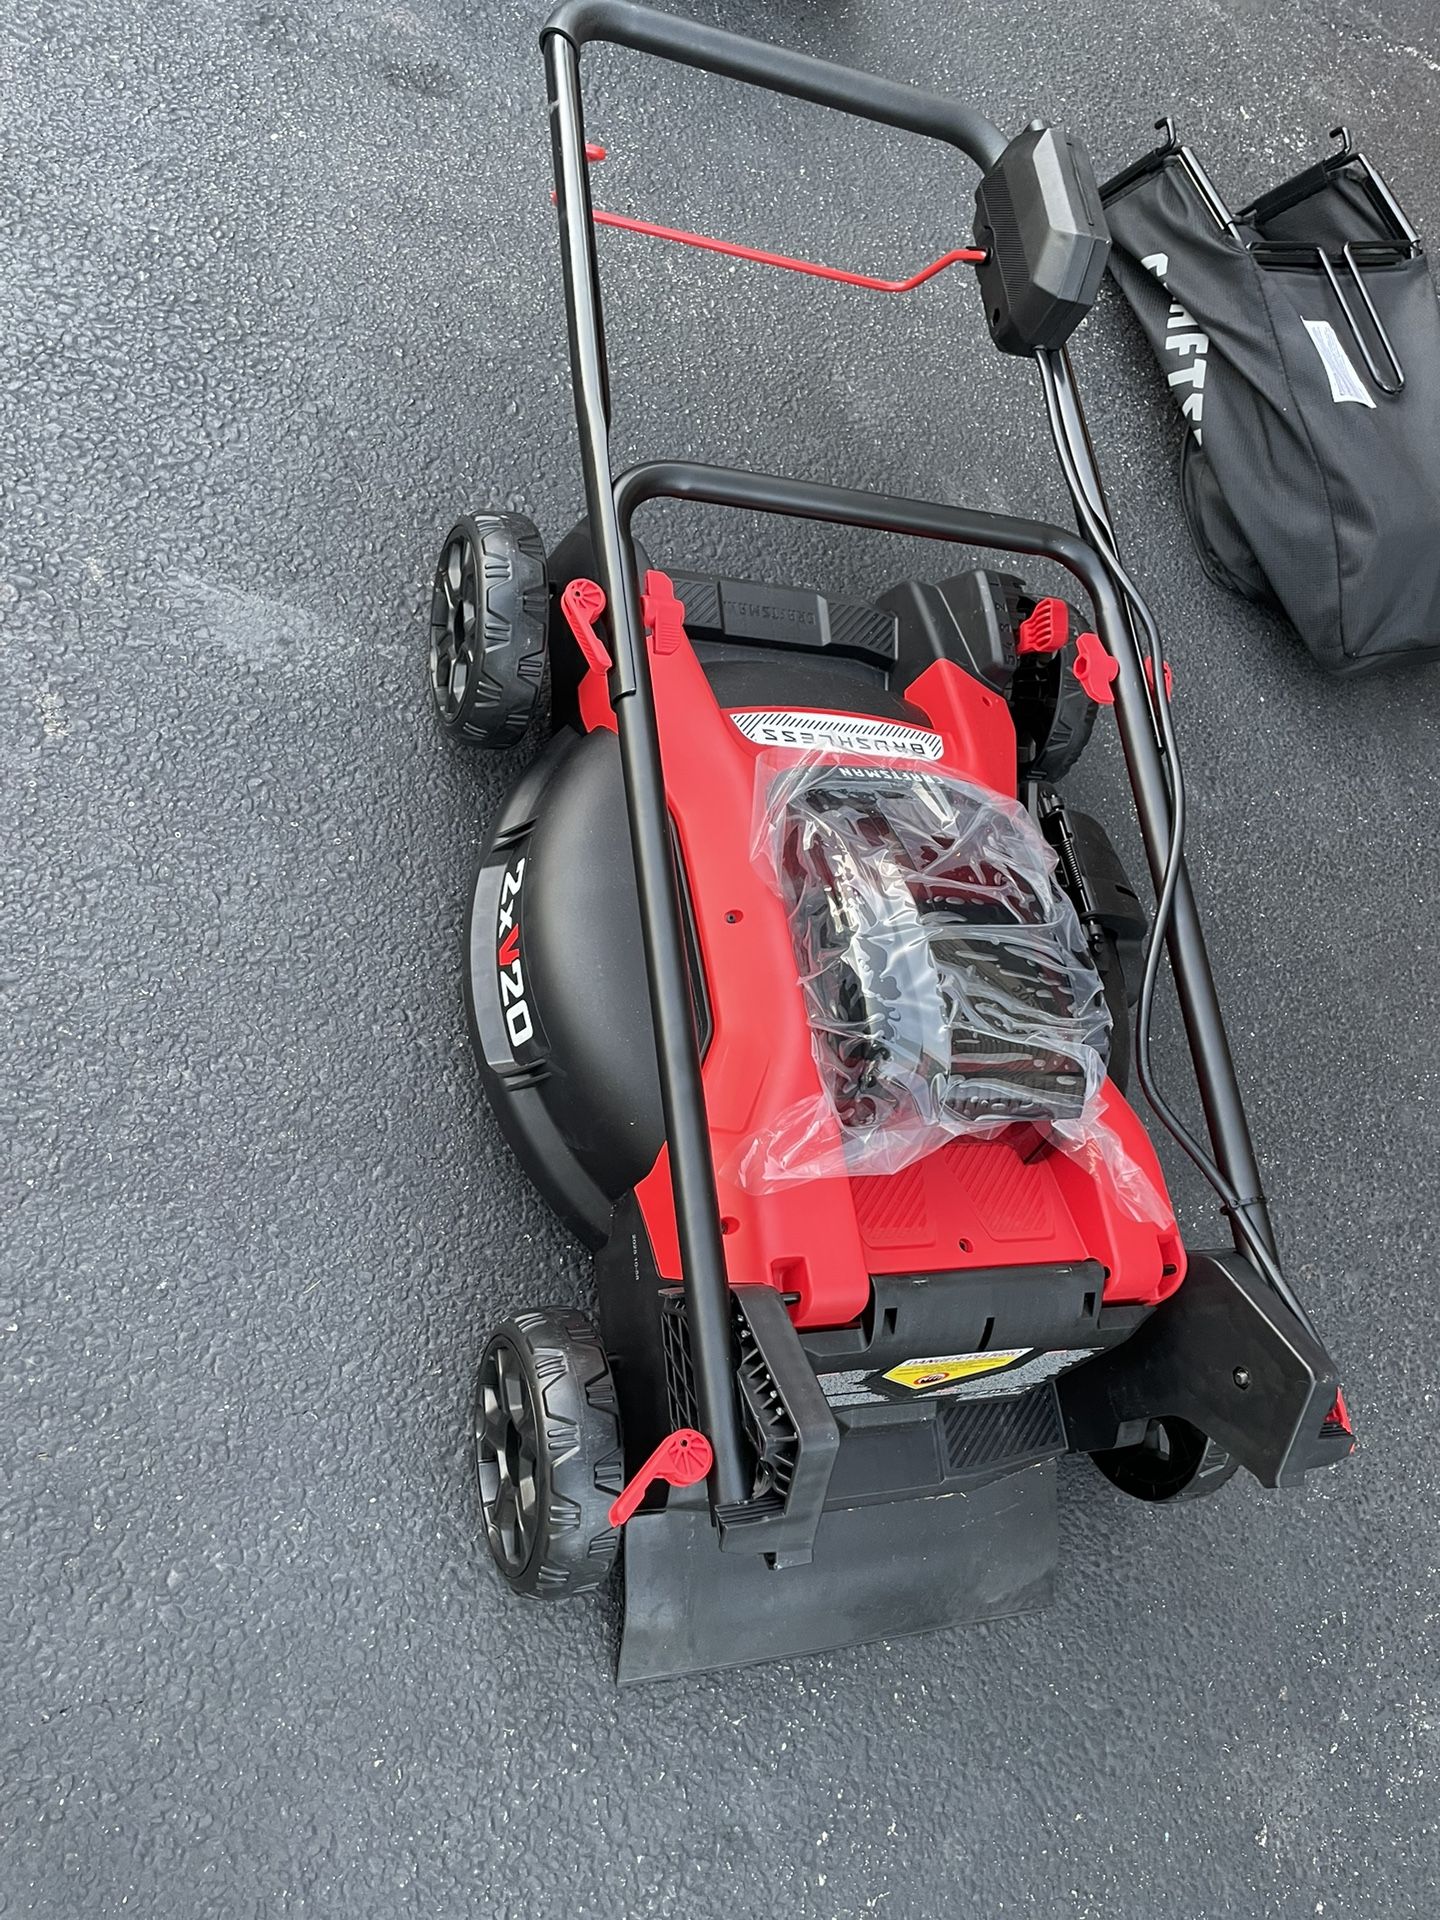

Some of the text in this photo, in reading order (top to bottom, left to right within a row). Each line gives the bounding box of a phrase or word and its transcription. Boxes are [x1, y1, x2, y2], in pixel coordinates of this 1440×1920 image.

[1141, 253, 1209, 446] CAFTS
[762, 728, 926, 755] BRUSHLESS
[838, 767, 945, 785] CRAFTSMAN
